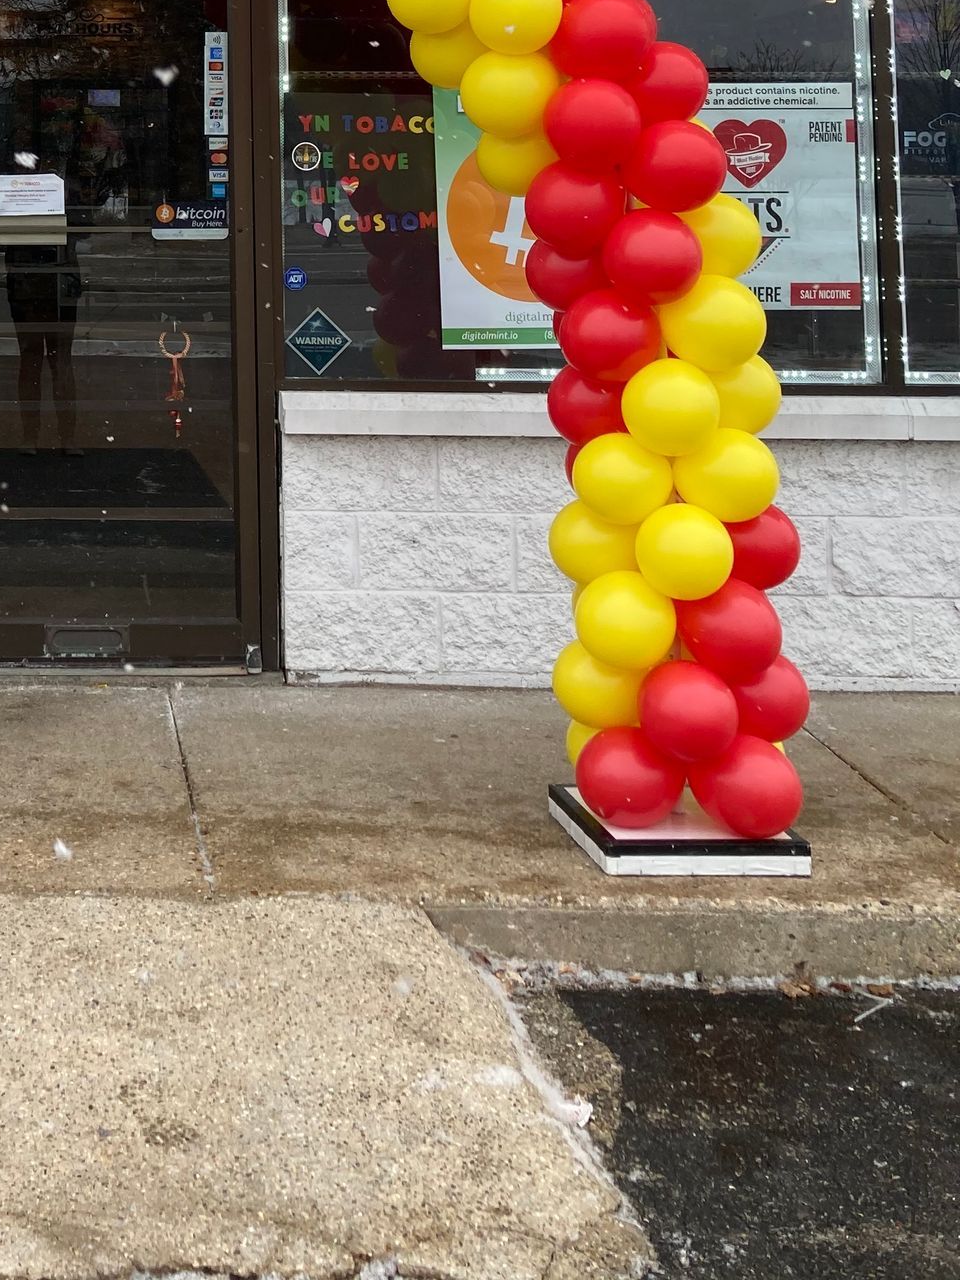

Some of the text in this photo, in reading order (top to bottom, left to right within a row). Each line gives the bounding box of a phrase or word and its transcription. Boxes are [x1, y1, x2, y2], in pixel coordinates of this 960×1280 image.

[715, 87, 753, 98] product
[756, 86, 797, 95] contains
[799, 86, 841, 95] nicotine.
[727, 96, 771, 106] addictive
[773, 96, 819, 106] chemical.
[298, 114, 330, 132] YN
[809, 121, 842, 133] PATENT
[809, 132, 843, 143] PENDING
[903, 130, 947, 147] FOG
[348, 152, 409, 171] LOVE
[212, 171, 227, 179] VISA
[291, 186, 340, 208] OUR
[176, 206, 226, 220] bitcoin
[191, 220, 206, 228] Buy
[288, 274, 303, 283] ADT
[800, 289, 851, 300] SALT NICOTINE
[295, 336, 343, 345] WARNING
[461, 330, 518, 341] digitalmint.io
